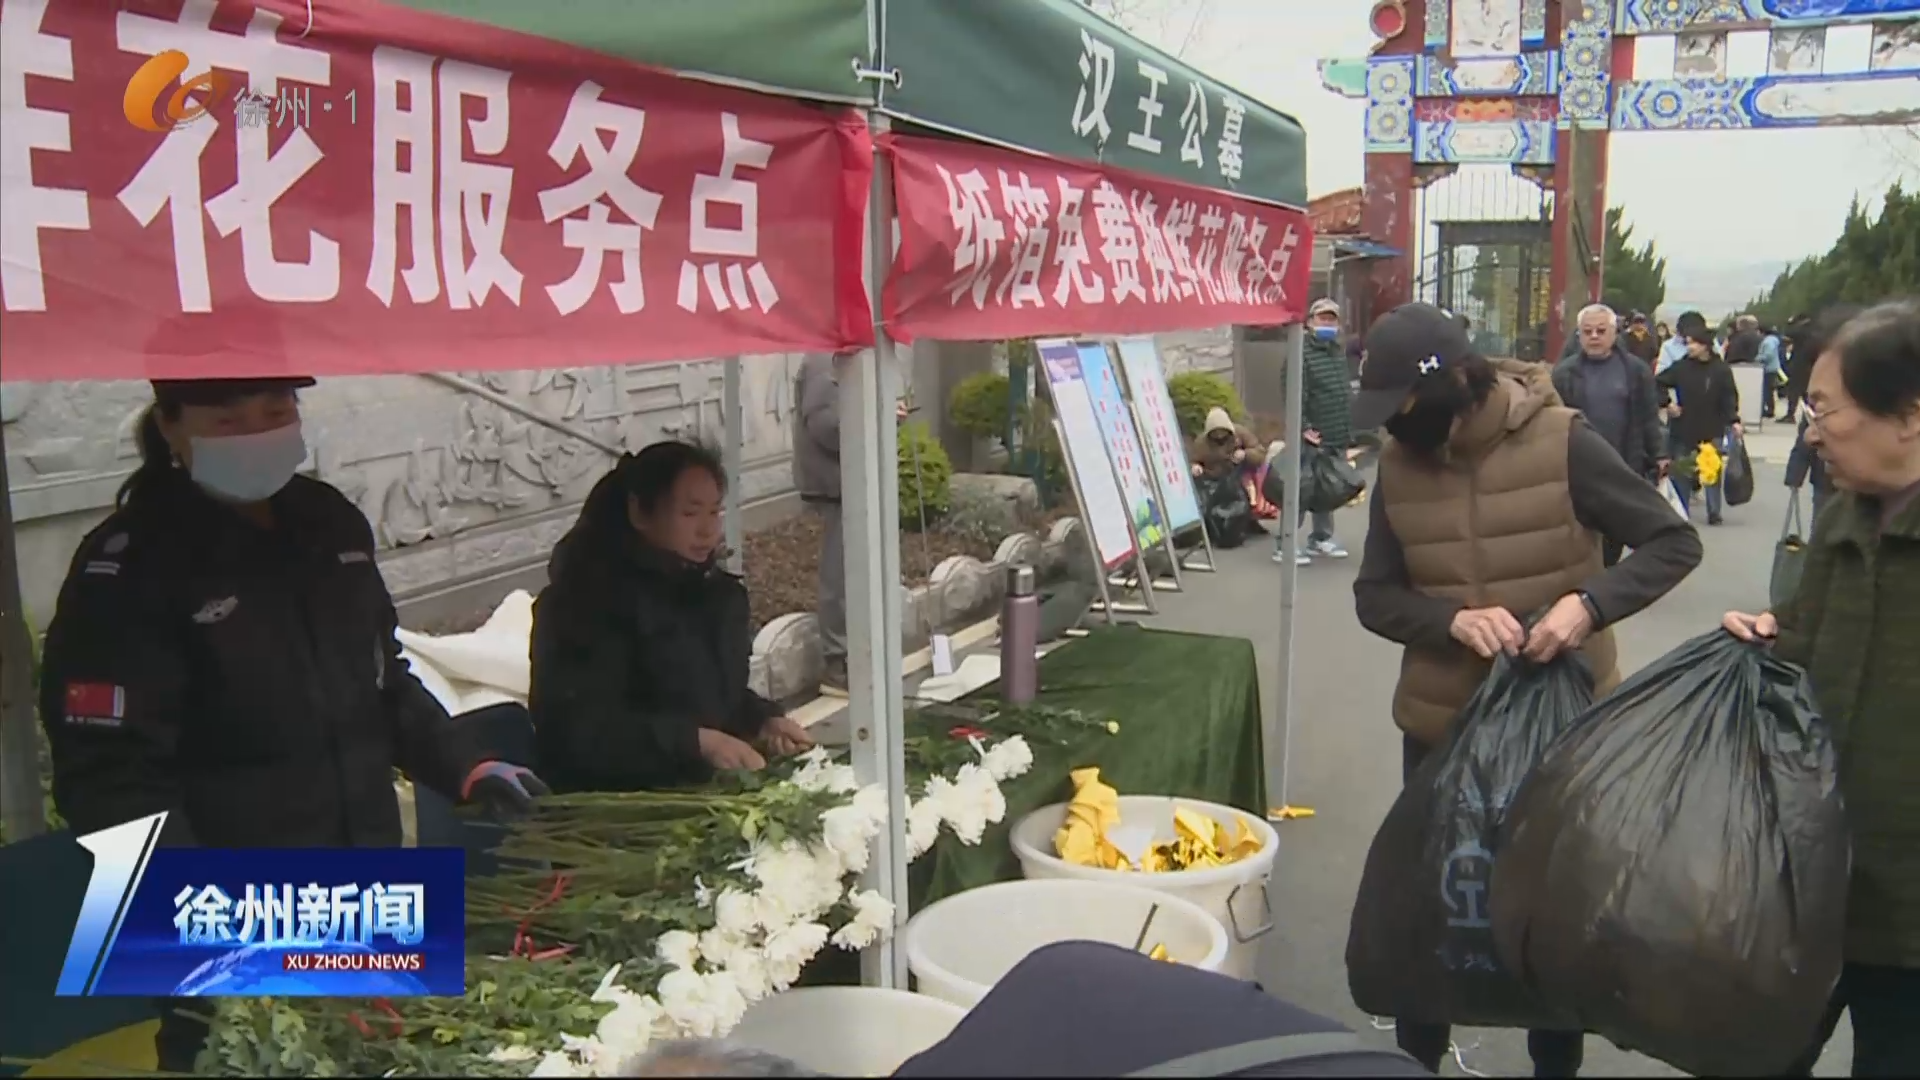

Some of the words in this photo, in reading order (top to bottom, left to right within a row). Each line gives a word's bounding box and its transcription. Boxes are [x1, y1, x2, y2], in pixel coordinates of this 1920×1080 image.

[1071, 28, 1246, 179] 汉王公墓
[936, 164, 1298, 310] 纸箔免费换鲜花服务点
